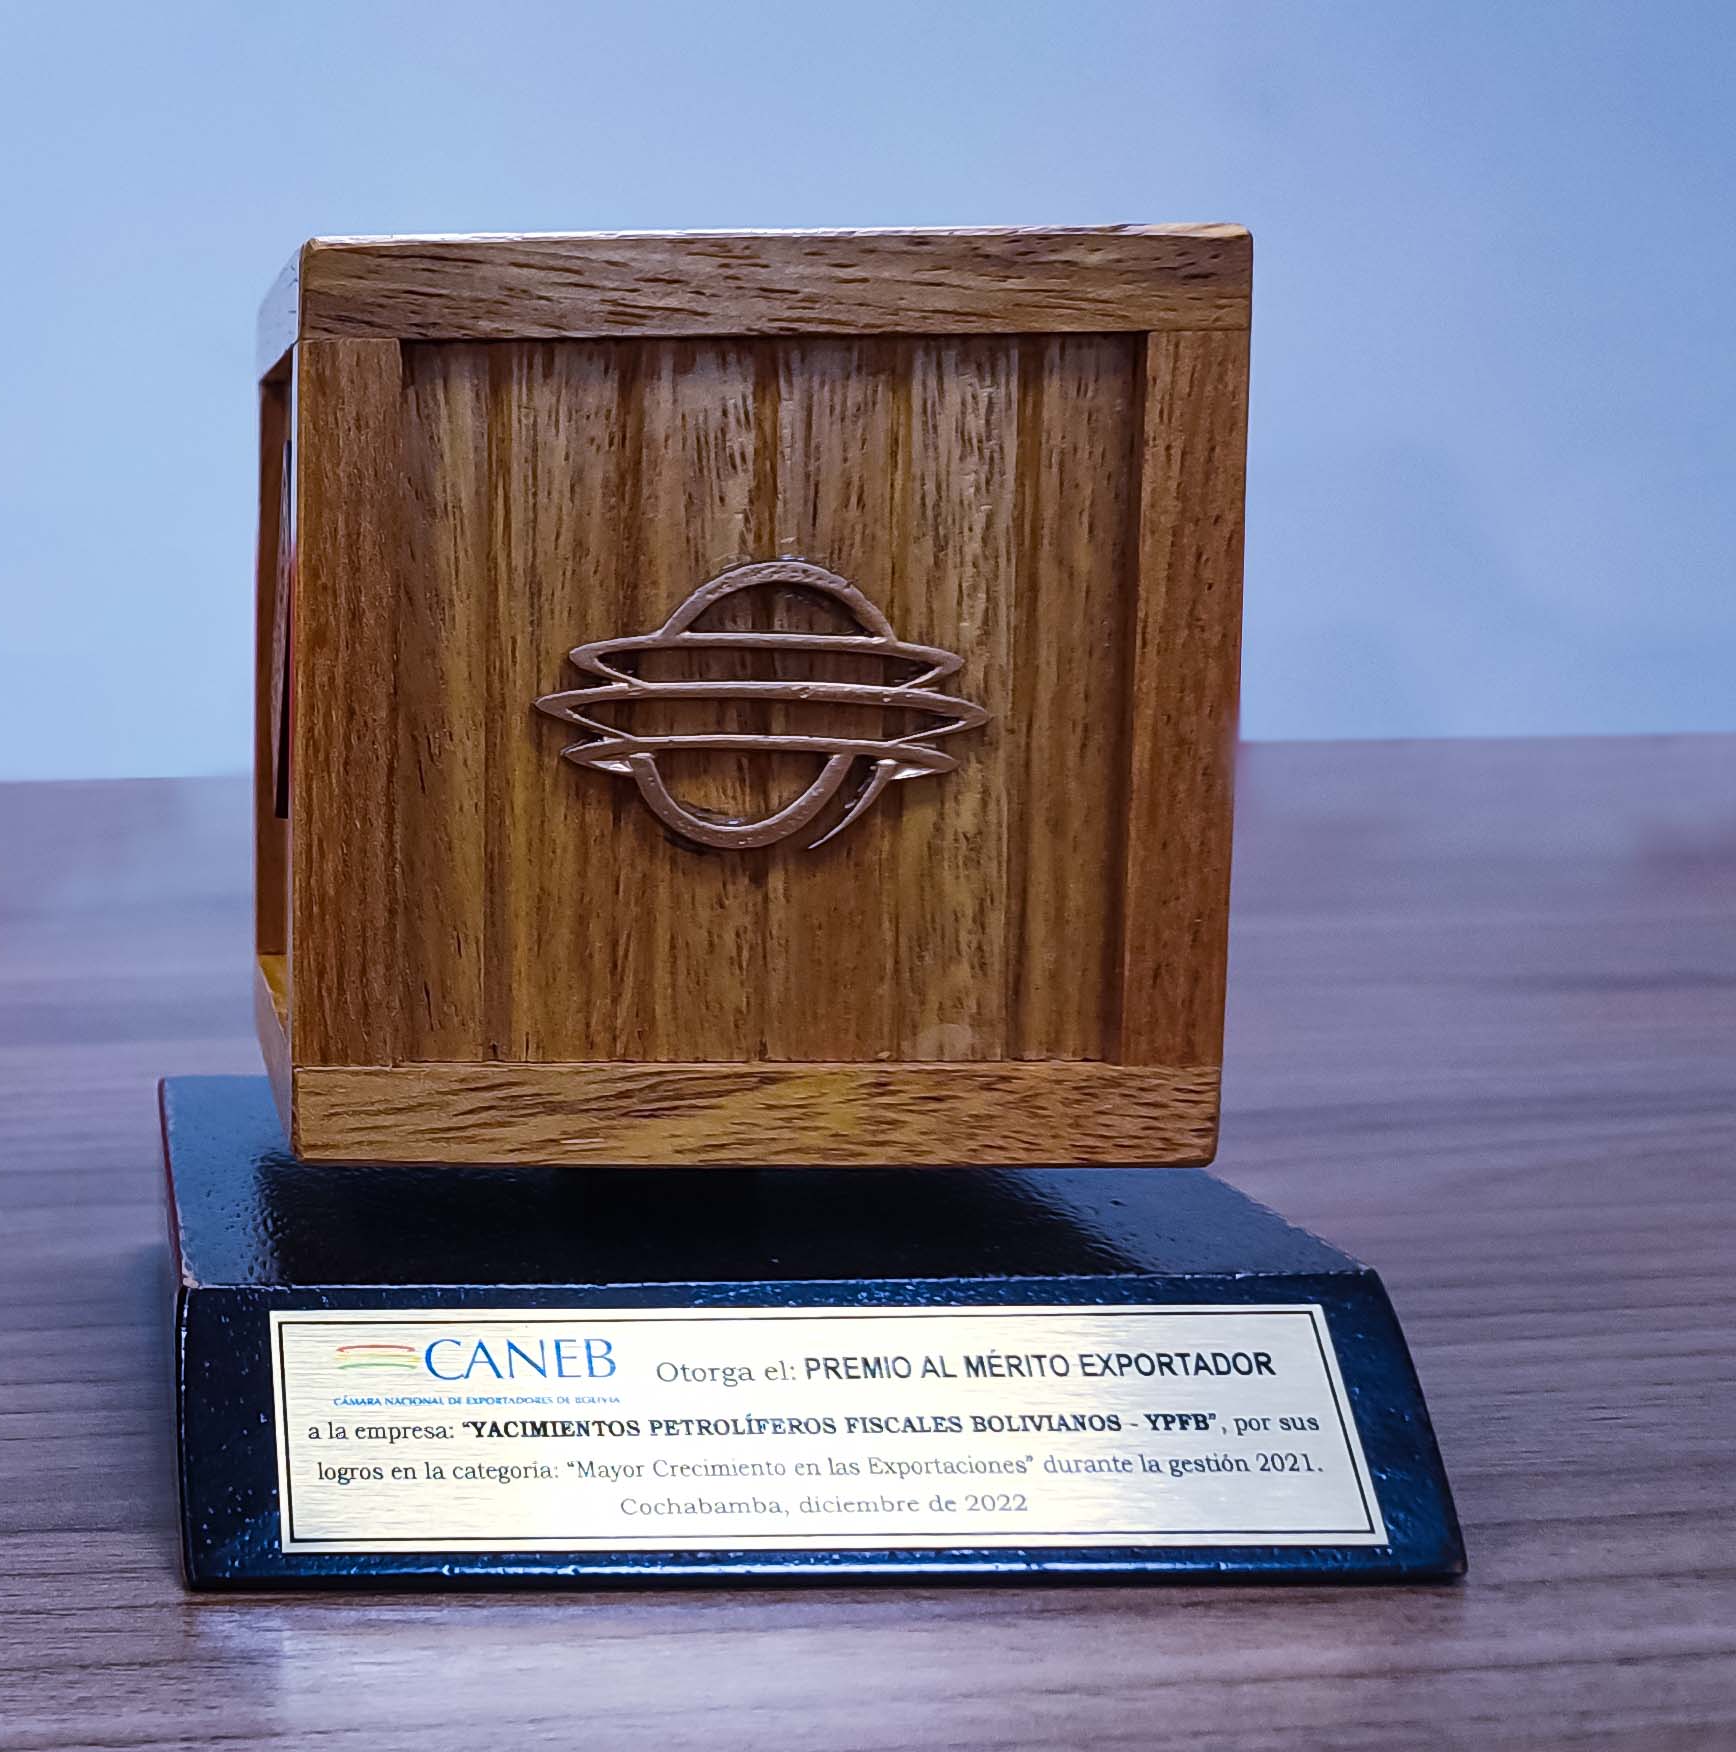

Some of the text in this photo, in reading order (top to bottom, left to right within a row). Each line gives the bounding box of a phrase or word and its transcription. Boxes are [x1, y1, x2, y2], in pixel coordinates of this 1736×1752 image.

[425, 1338, 616, 1380] CANEB
[656, 1349, 1276, 1387] Otorga el: PREMIO AL MÉRITO EXPORTADOR
[334, 1395, 620, 1406] CÁMARA NACIONAL DE EXPORTADORES DE BOLIVIA
[308, 1425, 321, 1440] a
[327, 1422, 348, 1440] la
[354, 1423, 455, 1443] empresa:
[648, 1414, 837, 1434] PETROLÍFEROS
[845, 1416, 963, 1434] FISCALES
[971, 1414, 1122, 1433] BOLIVIANOS
[1235, 1416, 1272, 1436] por
[1279, 1416, 1320, 1431] sus
[317, 1462, 383, 1485] logros
[391, 1464, 418, 1480] en
[425, 1461, 446, 1480] la
[652, 1458, 786, 1478] Crecimiento
[794, 1462, 821, 1476] en
[828, 1457, 860, 1476] las
[1043, 1454, 1134, 1475] durante
[1141, 1454, 1163, 1473] la
[1169, 1453, 1250, 1476] gestión
[1256, 1453, 1324, 1472] 2021.
[621, 1494, 1028, 1517] Cochabamba, diciembre de 2022
